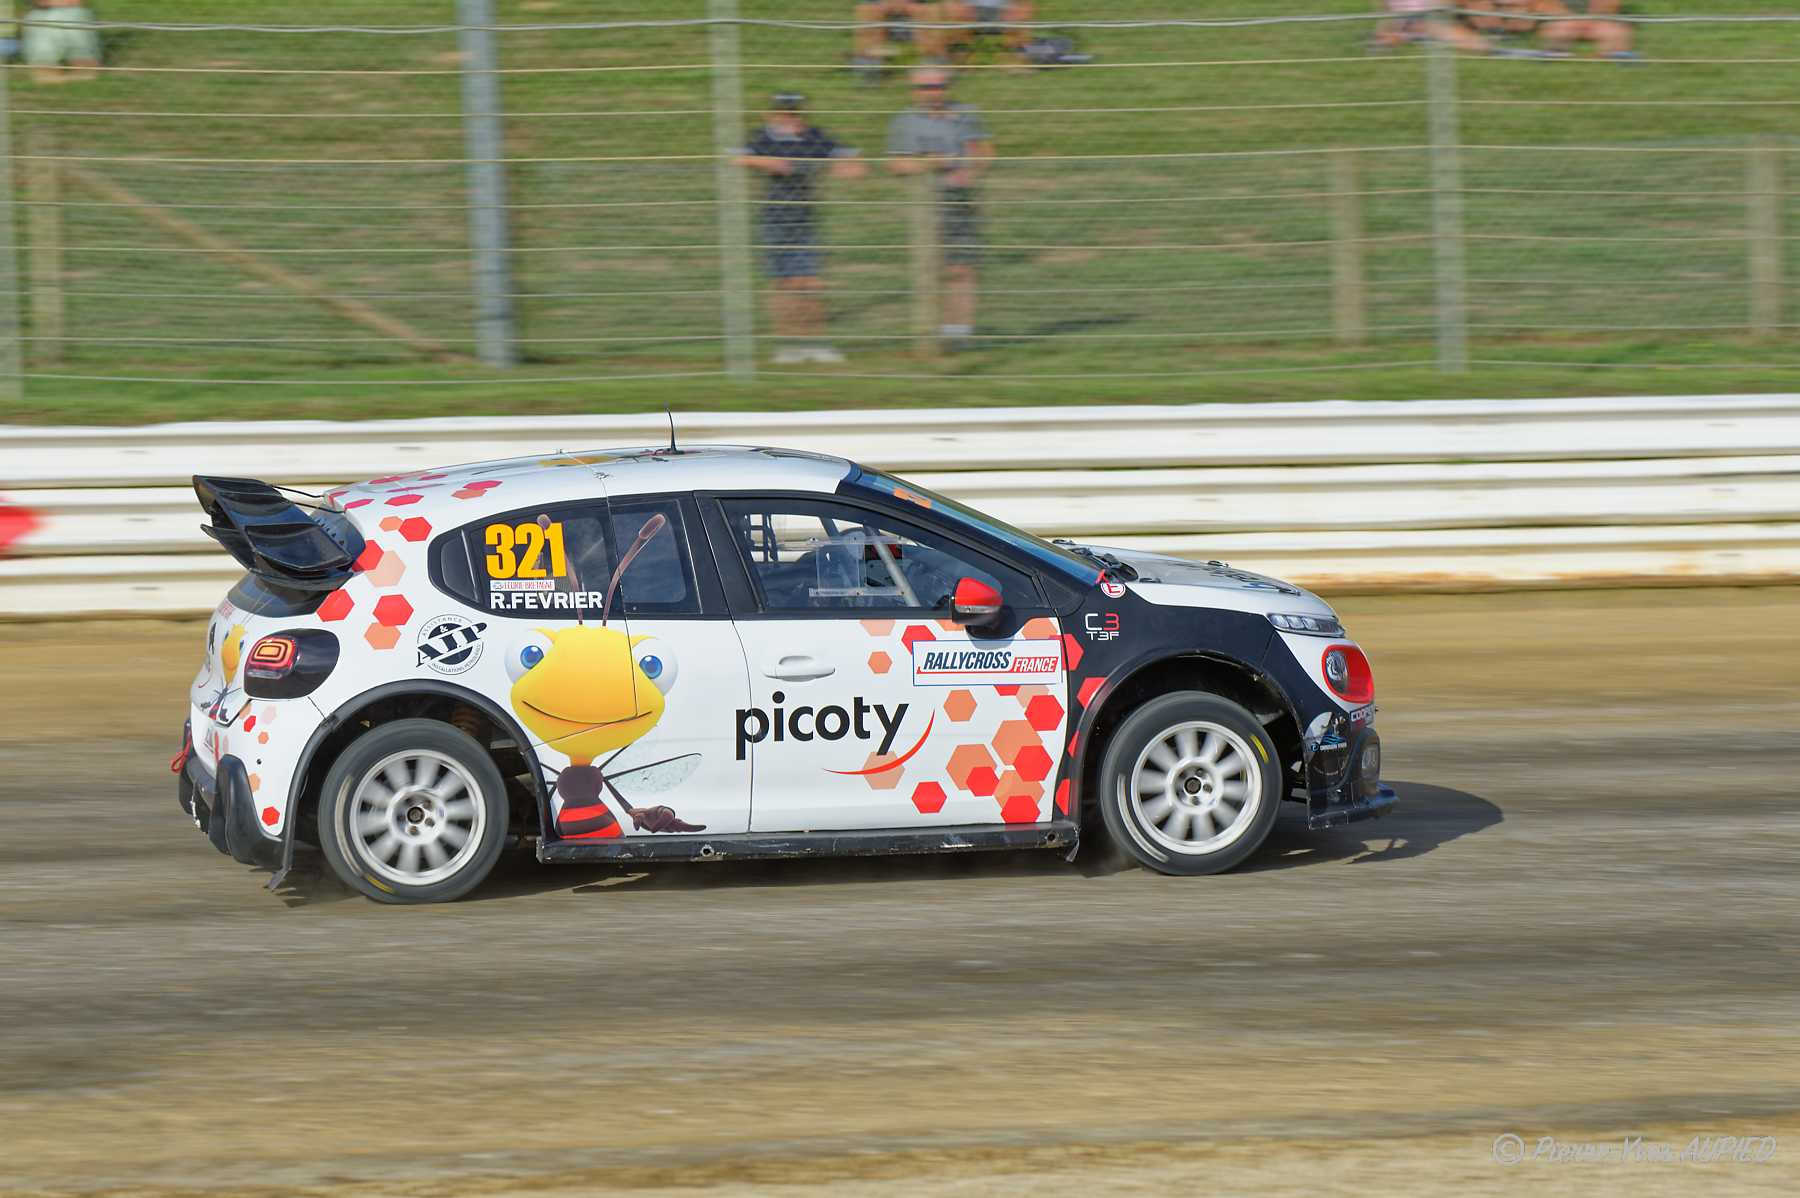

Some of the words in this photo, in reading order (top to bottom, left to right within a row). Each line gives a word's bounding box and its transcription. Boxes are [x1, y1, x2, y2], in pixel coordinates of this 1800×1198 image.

[485, 522, 567, 579] 321
[490, 591, 603, 609] R.FEVRIER
[1085, 612, 1120, 631] C3
[1086, 631, 1120, 641] T3F
[923, 650, 1012, 671] RALLYCROSS
[1014, 657, 1057, 672] FRANCE
[735, 690, 909, 760] picoty
